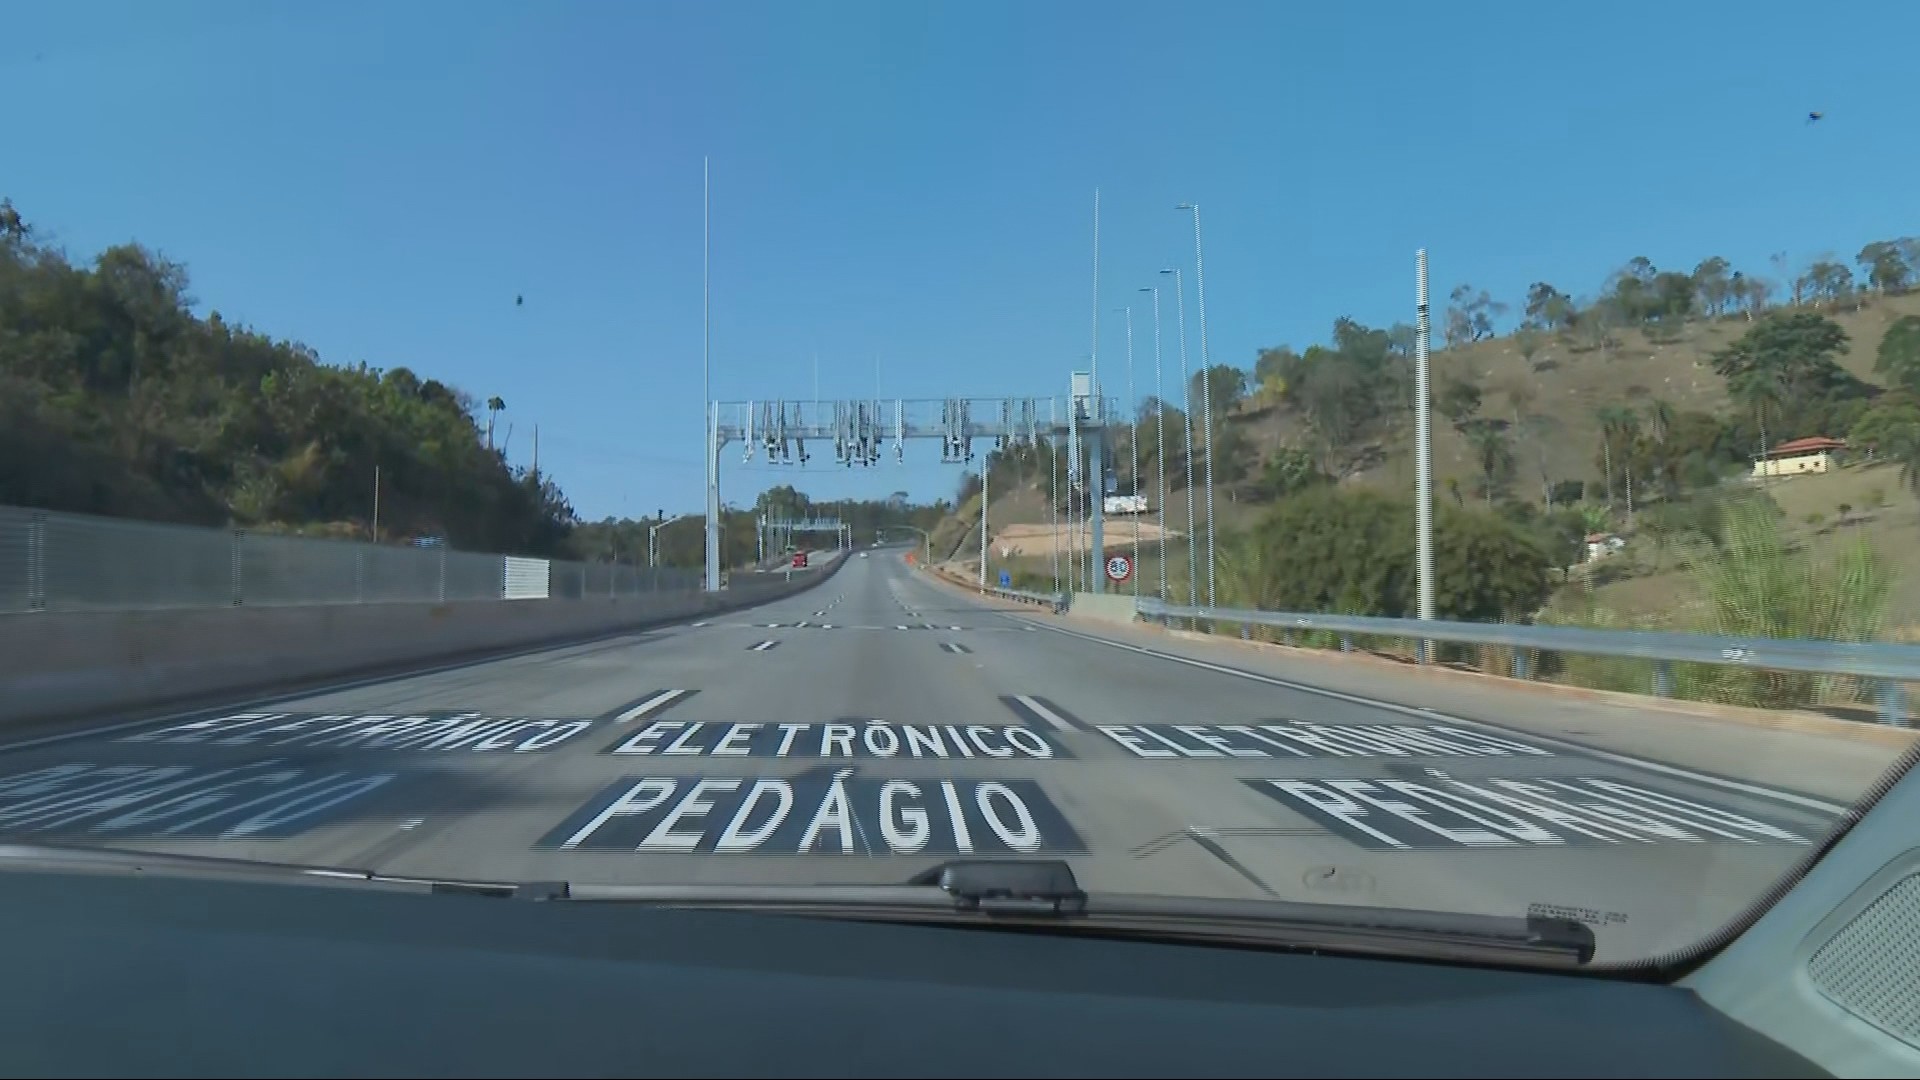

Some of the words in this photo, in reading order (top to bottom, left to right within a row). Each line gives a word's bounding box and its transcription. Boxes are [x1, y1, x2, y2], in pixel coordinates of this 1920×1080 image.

[1110, 560, 1127, 573] 80
[613, 718, 1054, 758] ELETRÔNICO
[1094, 719, 1555, 757] ELETRÔNICO
[561, 766, 1042, 853] PEDÁGIO
[1265, 767, 1811, 849] PEDÁGIO
